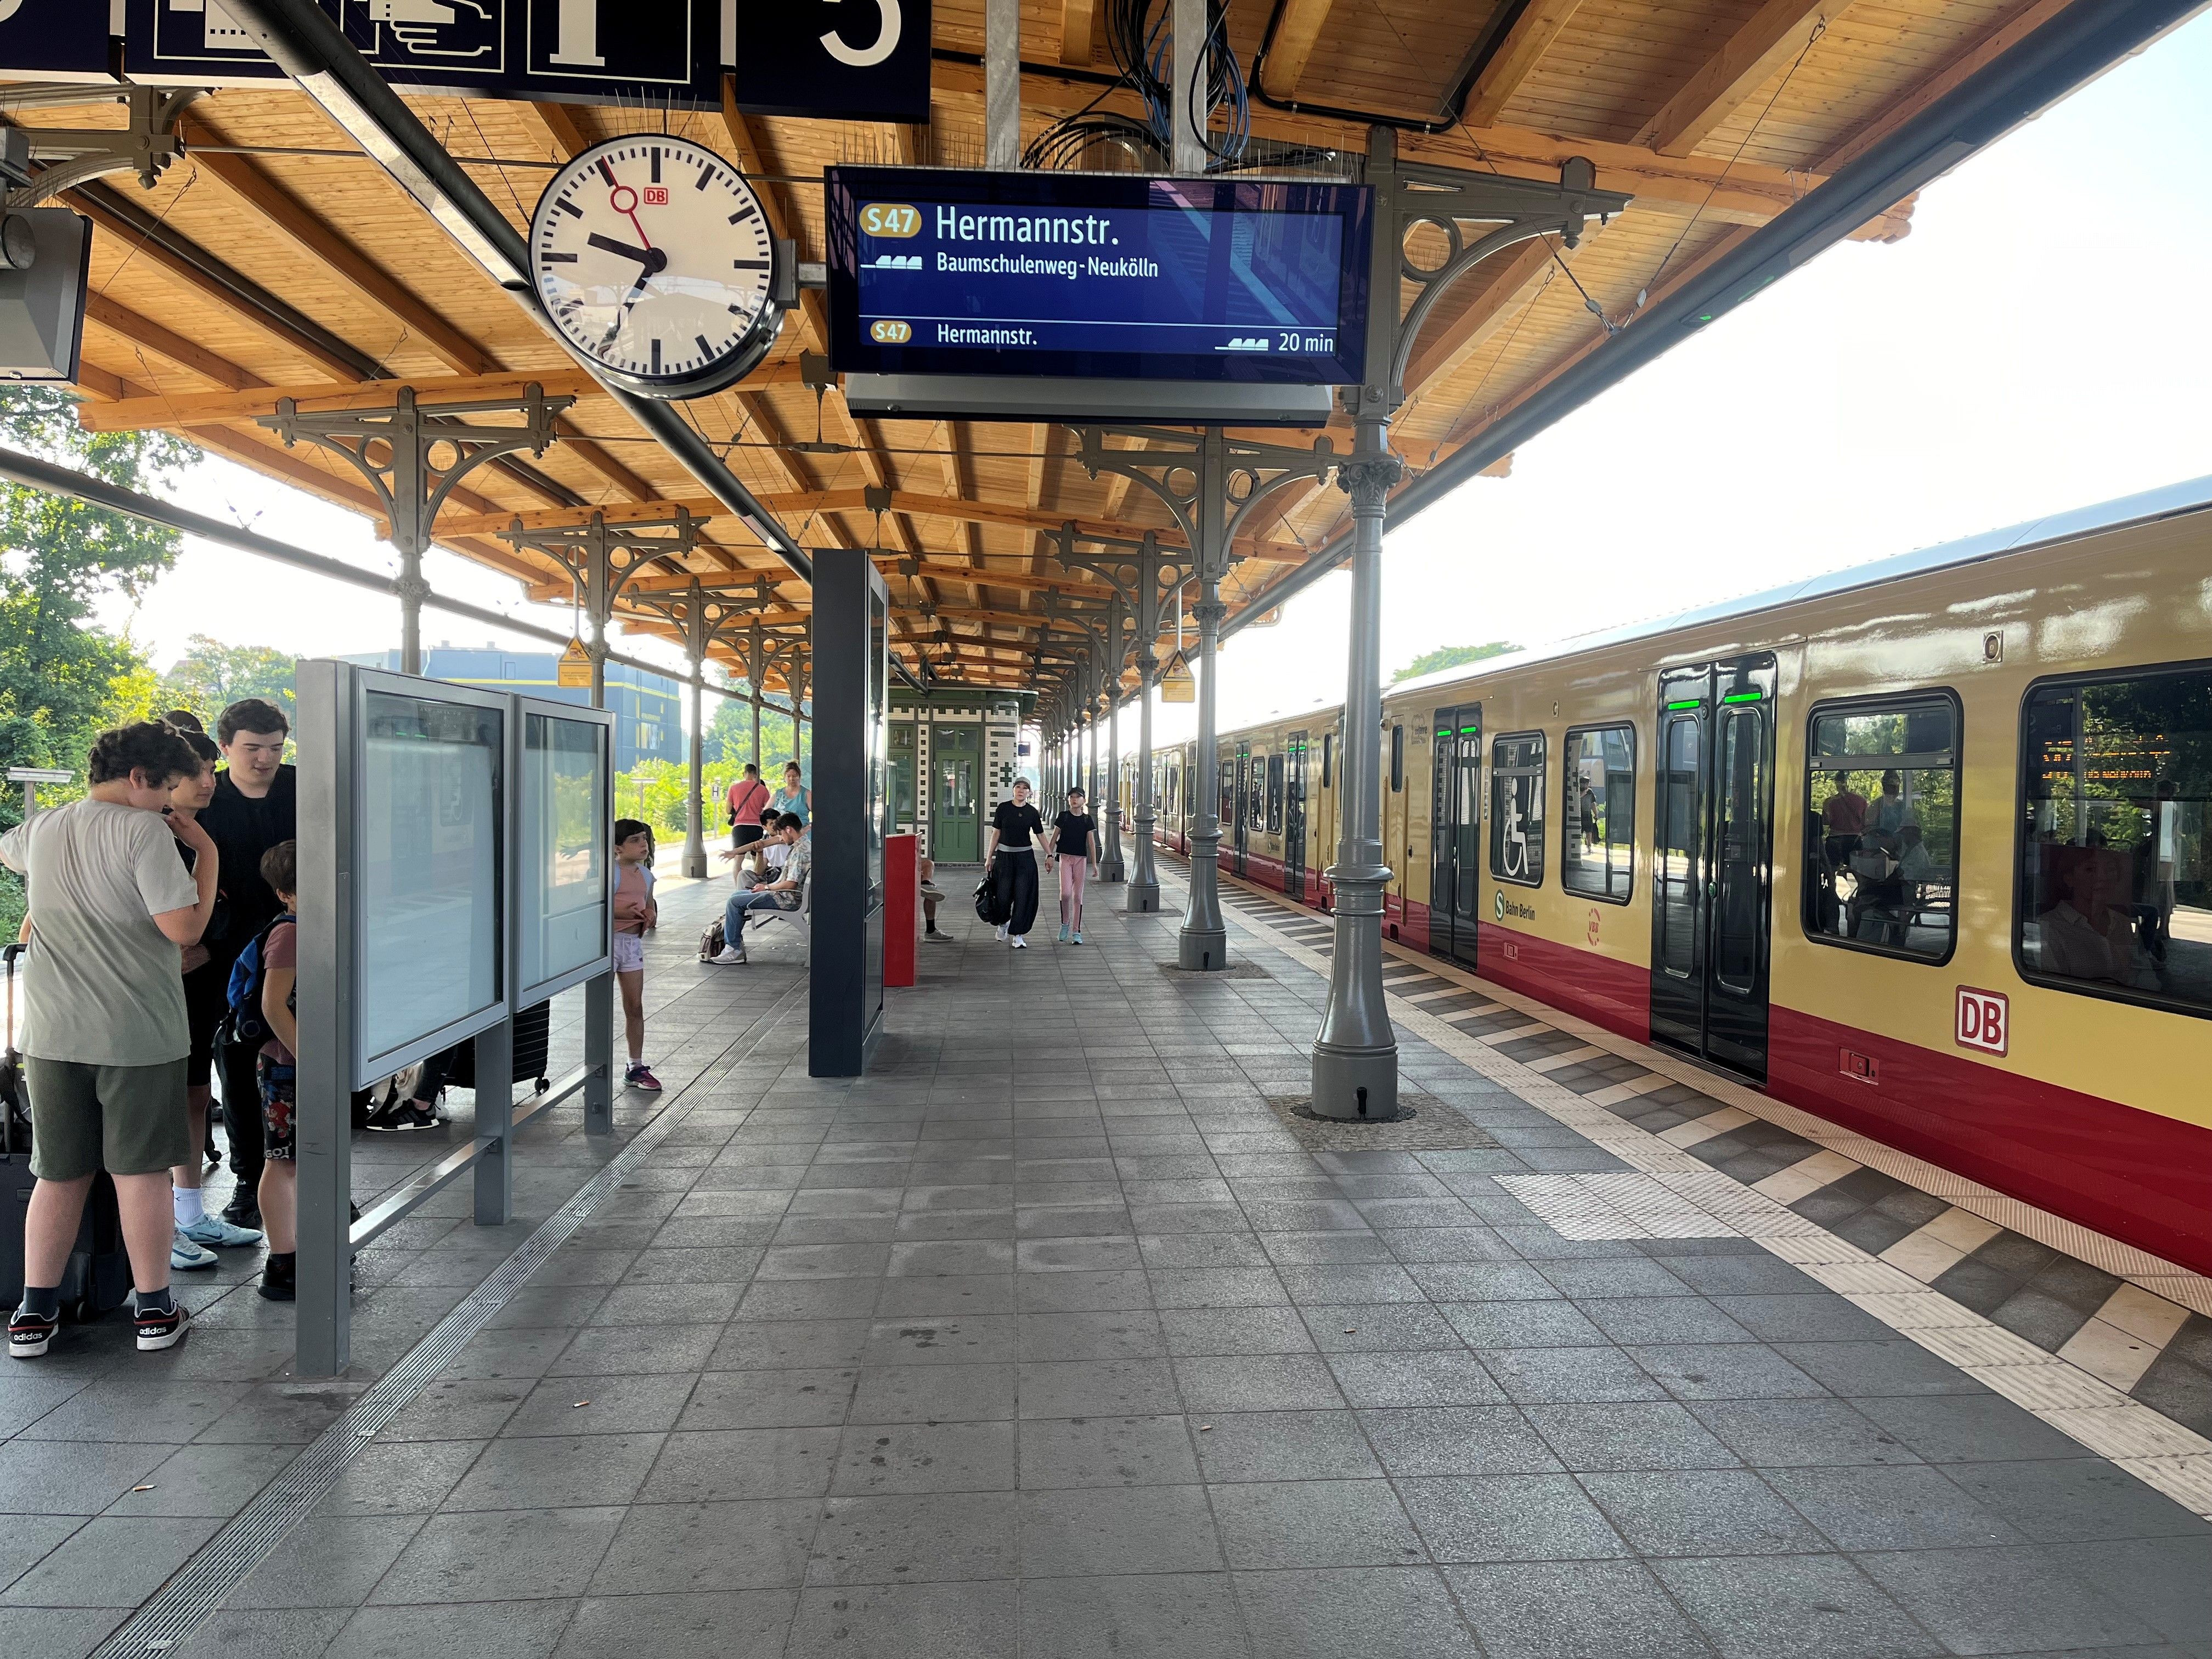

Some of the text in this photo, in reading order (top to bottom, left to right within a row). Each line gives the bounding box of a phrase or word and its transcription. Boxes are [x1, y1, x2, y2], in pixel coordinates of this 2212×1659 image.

[646, 189, 665, 202] DB
[937, 205, 1119, 245] Hermannstr.
[938, 323, 1037, 345] Hermannstr.
[1278, 332, 1300, 352] 20
[1305, 334, 1333, 352] min
[1496, 891, 1536, 921] S Bahn Berlin
[1960, 994, 2003, 1046] DB
[13, 1333, 43, 1341] adidas
[139, 1327, 167, 1335] adidas
